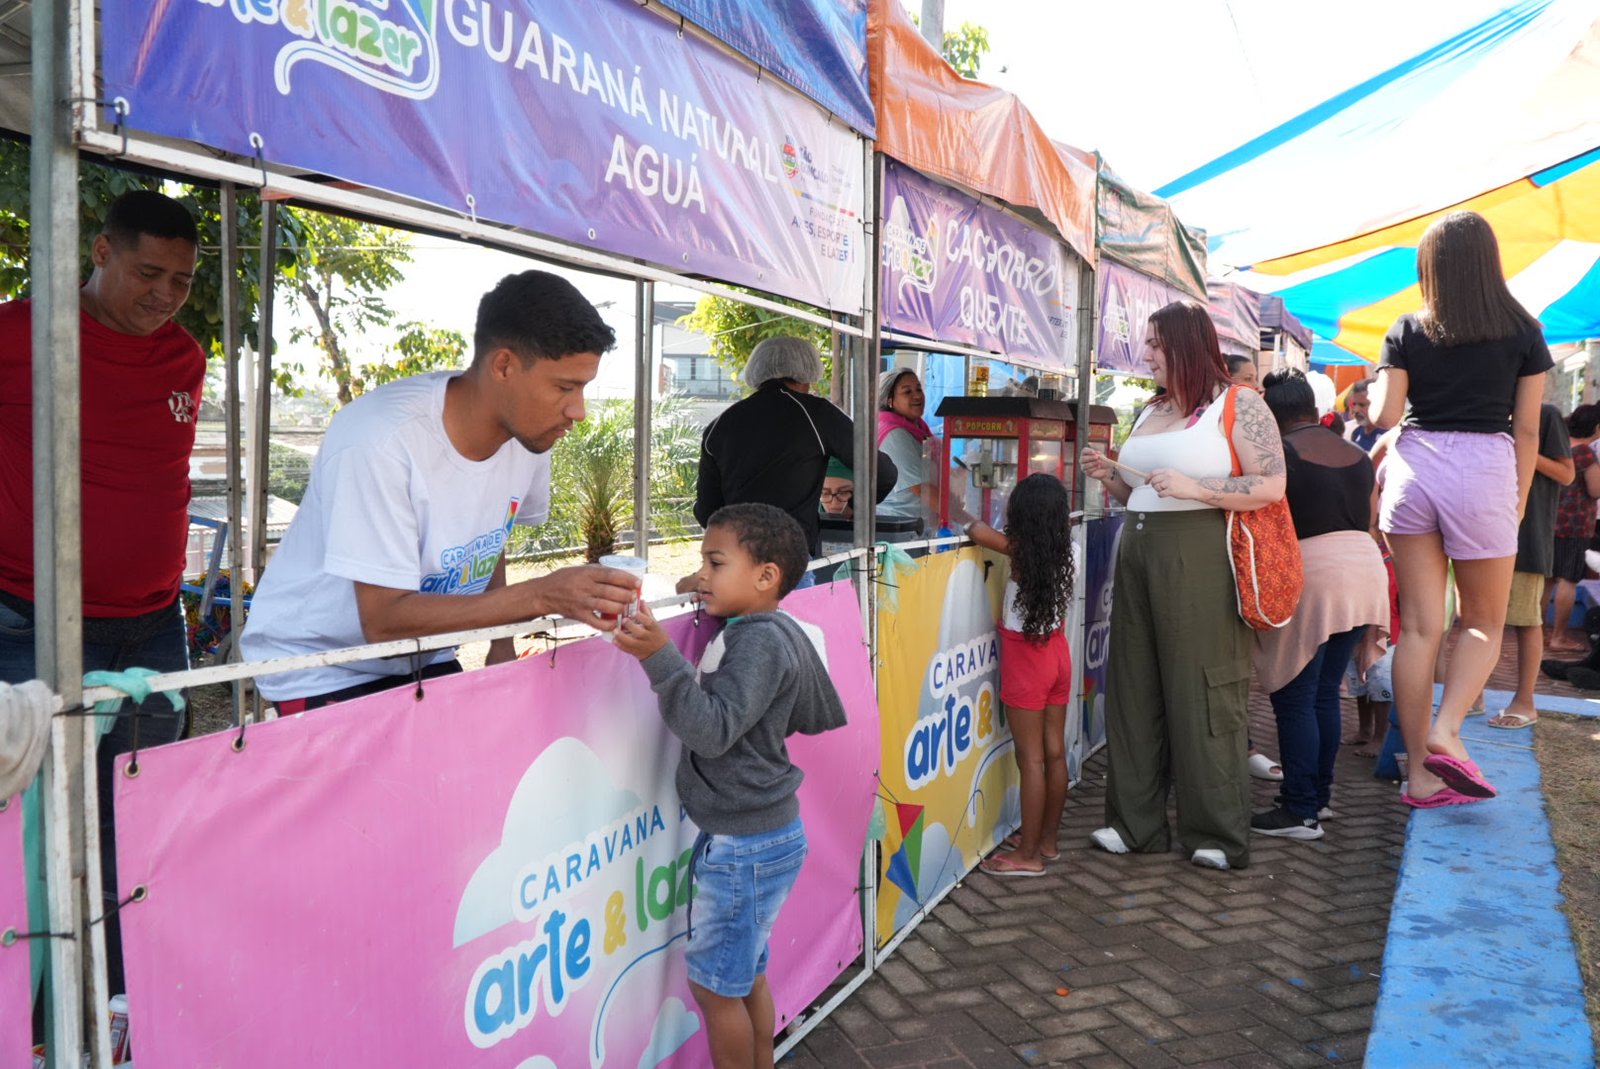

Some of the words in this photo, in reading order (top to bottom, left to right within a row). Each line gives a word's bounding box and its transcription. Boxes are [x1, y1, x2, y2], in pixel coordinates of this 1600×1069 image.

[318, 0, 418, 69] lazer
[444, 0, 652, 126] GUARANÁ
[659, 88, 778, 183] NATURAL
[604, 134, 707, 214] AGUÁ
[966, 420, 1002, 431] POPCORN
[908, 692, 971, 781] arte
[977, 689, 993, 740] &
[520, 804, 665, 910] CARAVANA
[474, 909, 591, 1034] arte
[603, 889, 627, 955] &
